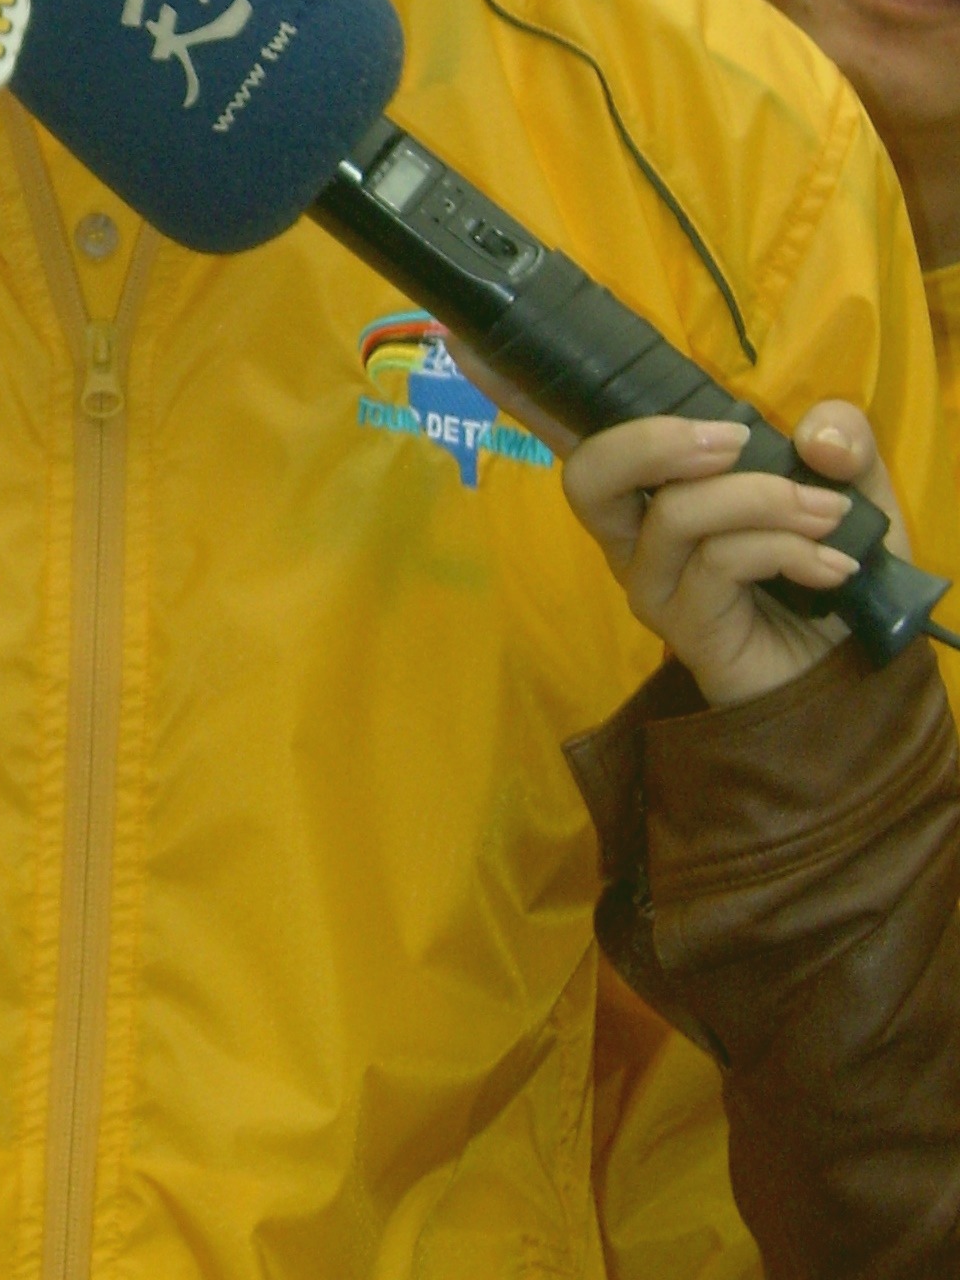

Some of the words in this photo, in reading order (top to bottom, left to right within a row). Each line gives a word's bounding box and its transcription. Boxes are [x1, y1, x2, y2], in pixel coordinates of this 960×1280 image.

[358, 396, 422, 436] TOUR
[427, 413, 459, 442] DE
[462, 421, 555, 468] TAIWAN
